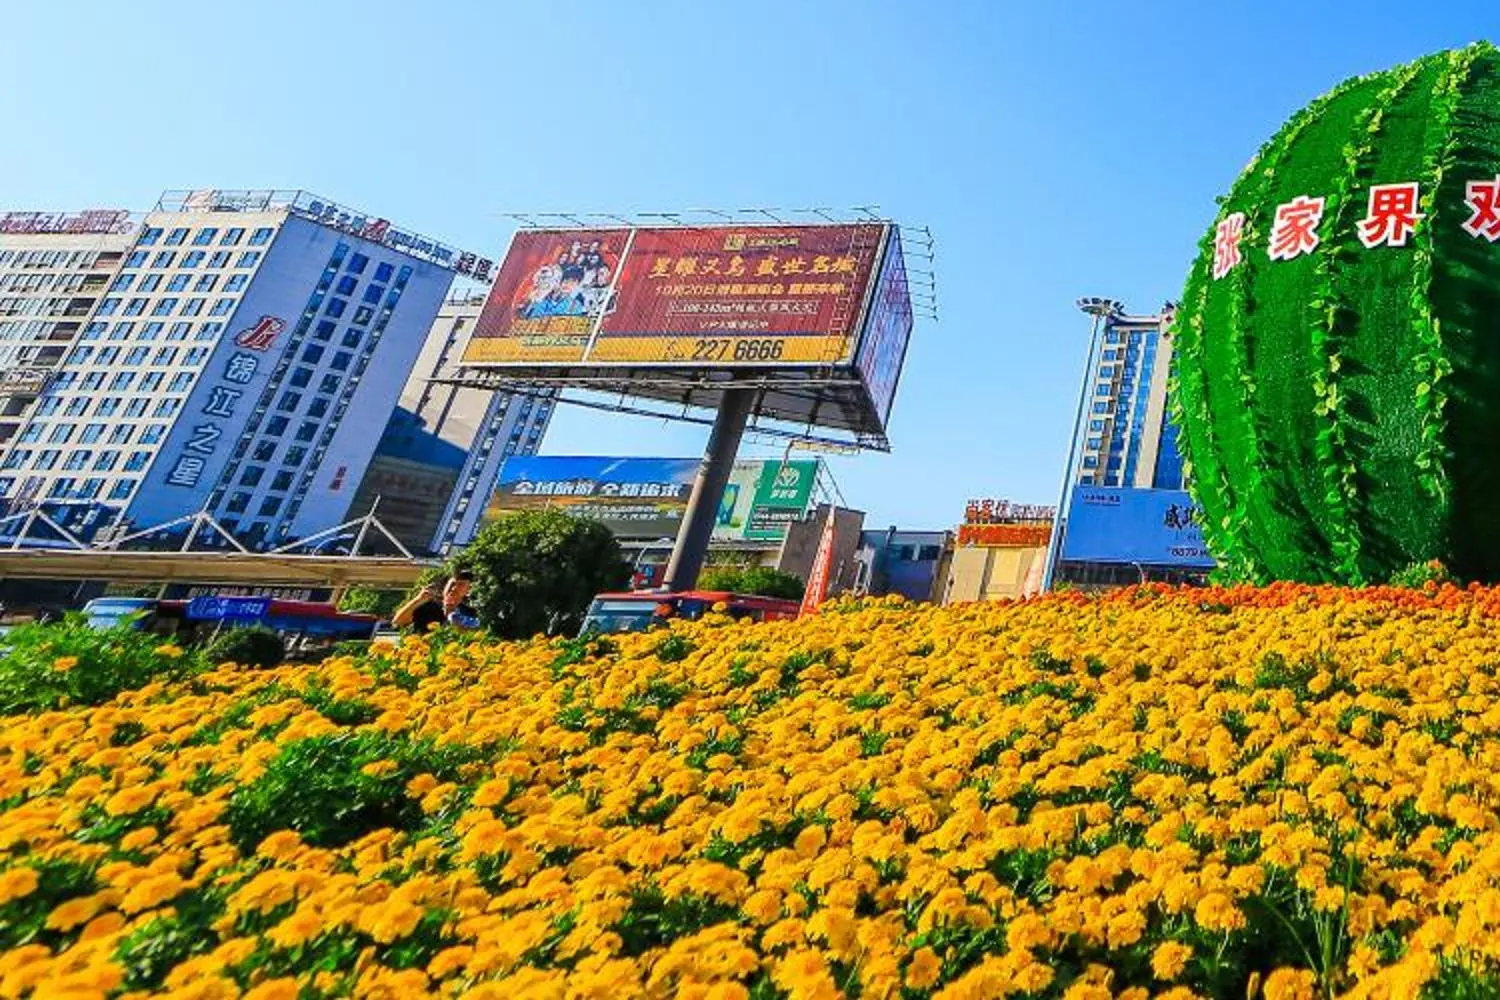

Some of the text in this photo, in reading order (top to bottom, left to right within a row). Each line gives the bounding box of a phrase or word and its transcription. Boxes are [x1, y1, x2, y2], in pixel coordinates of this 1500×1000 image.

[692, 339, 731, 361] 227
[733, 339, 785, 360] 6666
[166, 351, 260, 488] 锦江之星
